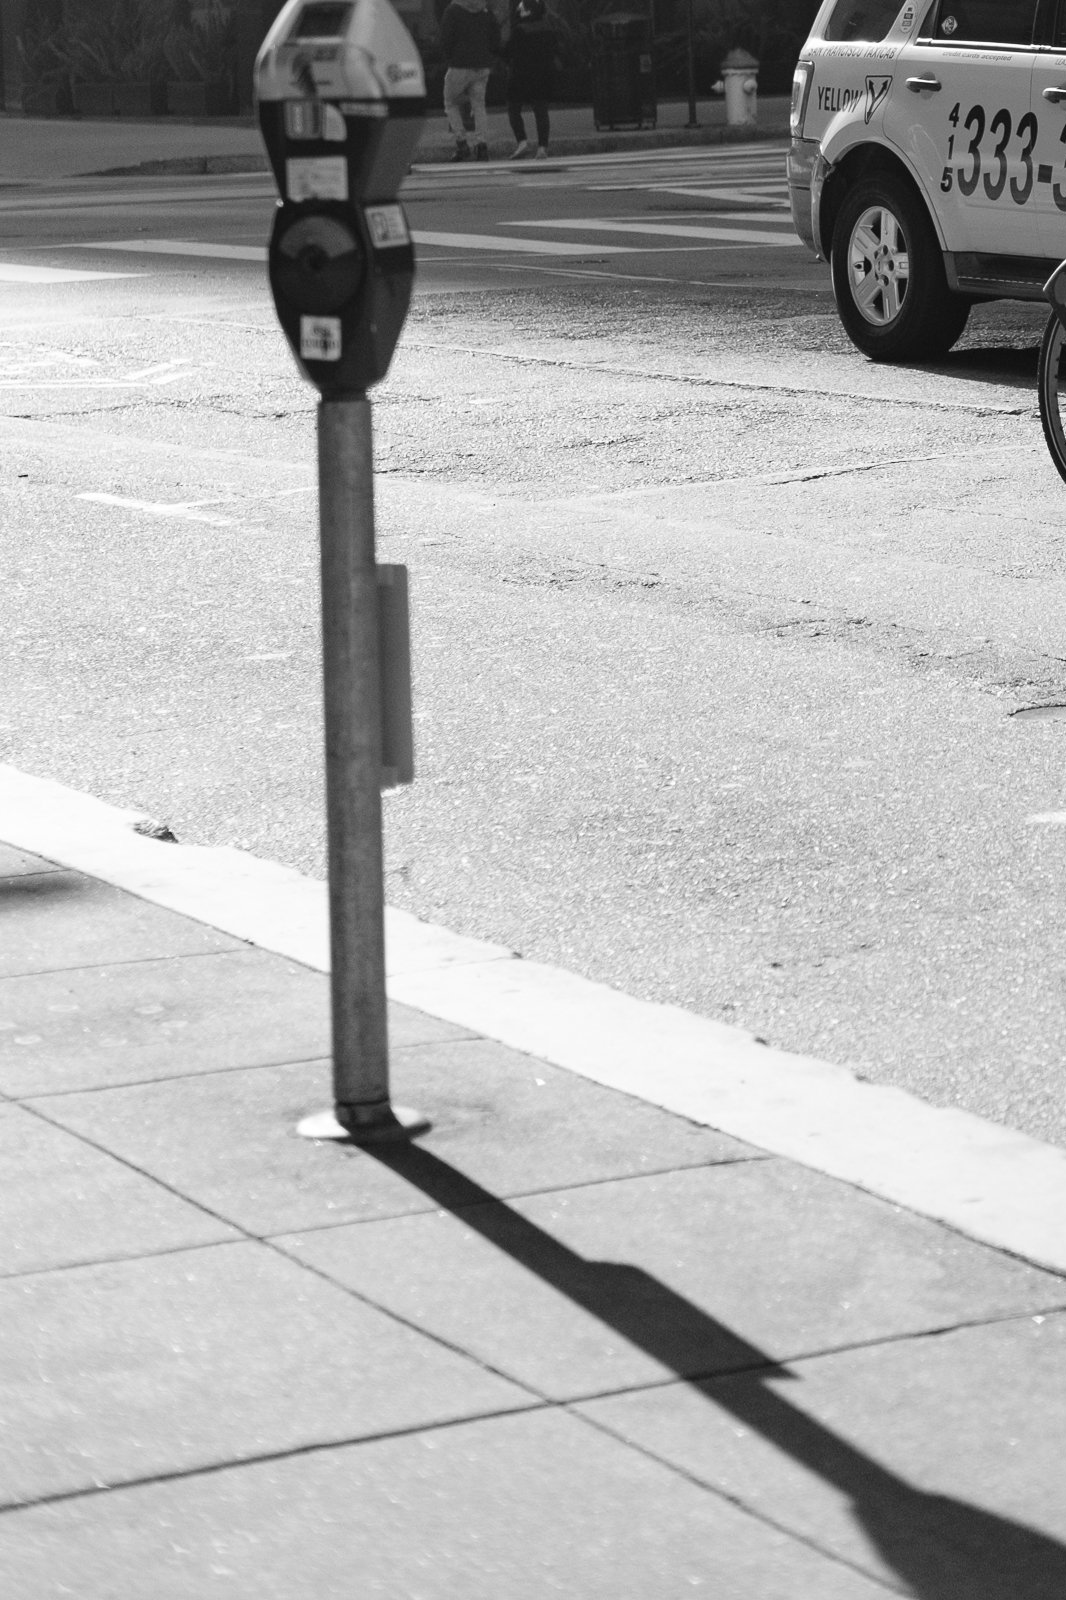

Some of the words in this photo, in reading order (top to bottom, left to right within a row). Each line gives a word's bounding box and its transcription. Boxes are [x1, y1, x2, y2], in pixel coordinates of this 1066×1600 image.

[824, 46, 861, 58] FRANCISCO
[862, 47, 896, 60] TAXICAB
[962, 52, 980, 60] cards
[981, 54, 1012, 63] accepted
[817, 85, 864, 113] YELLOW
